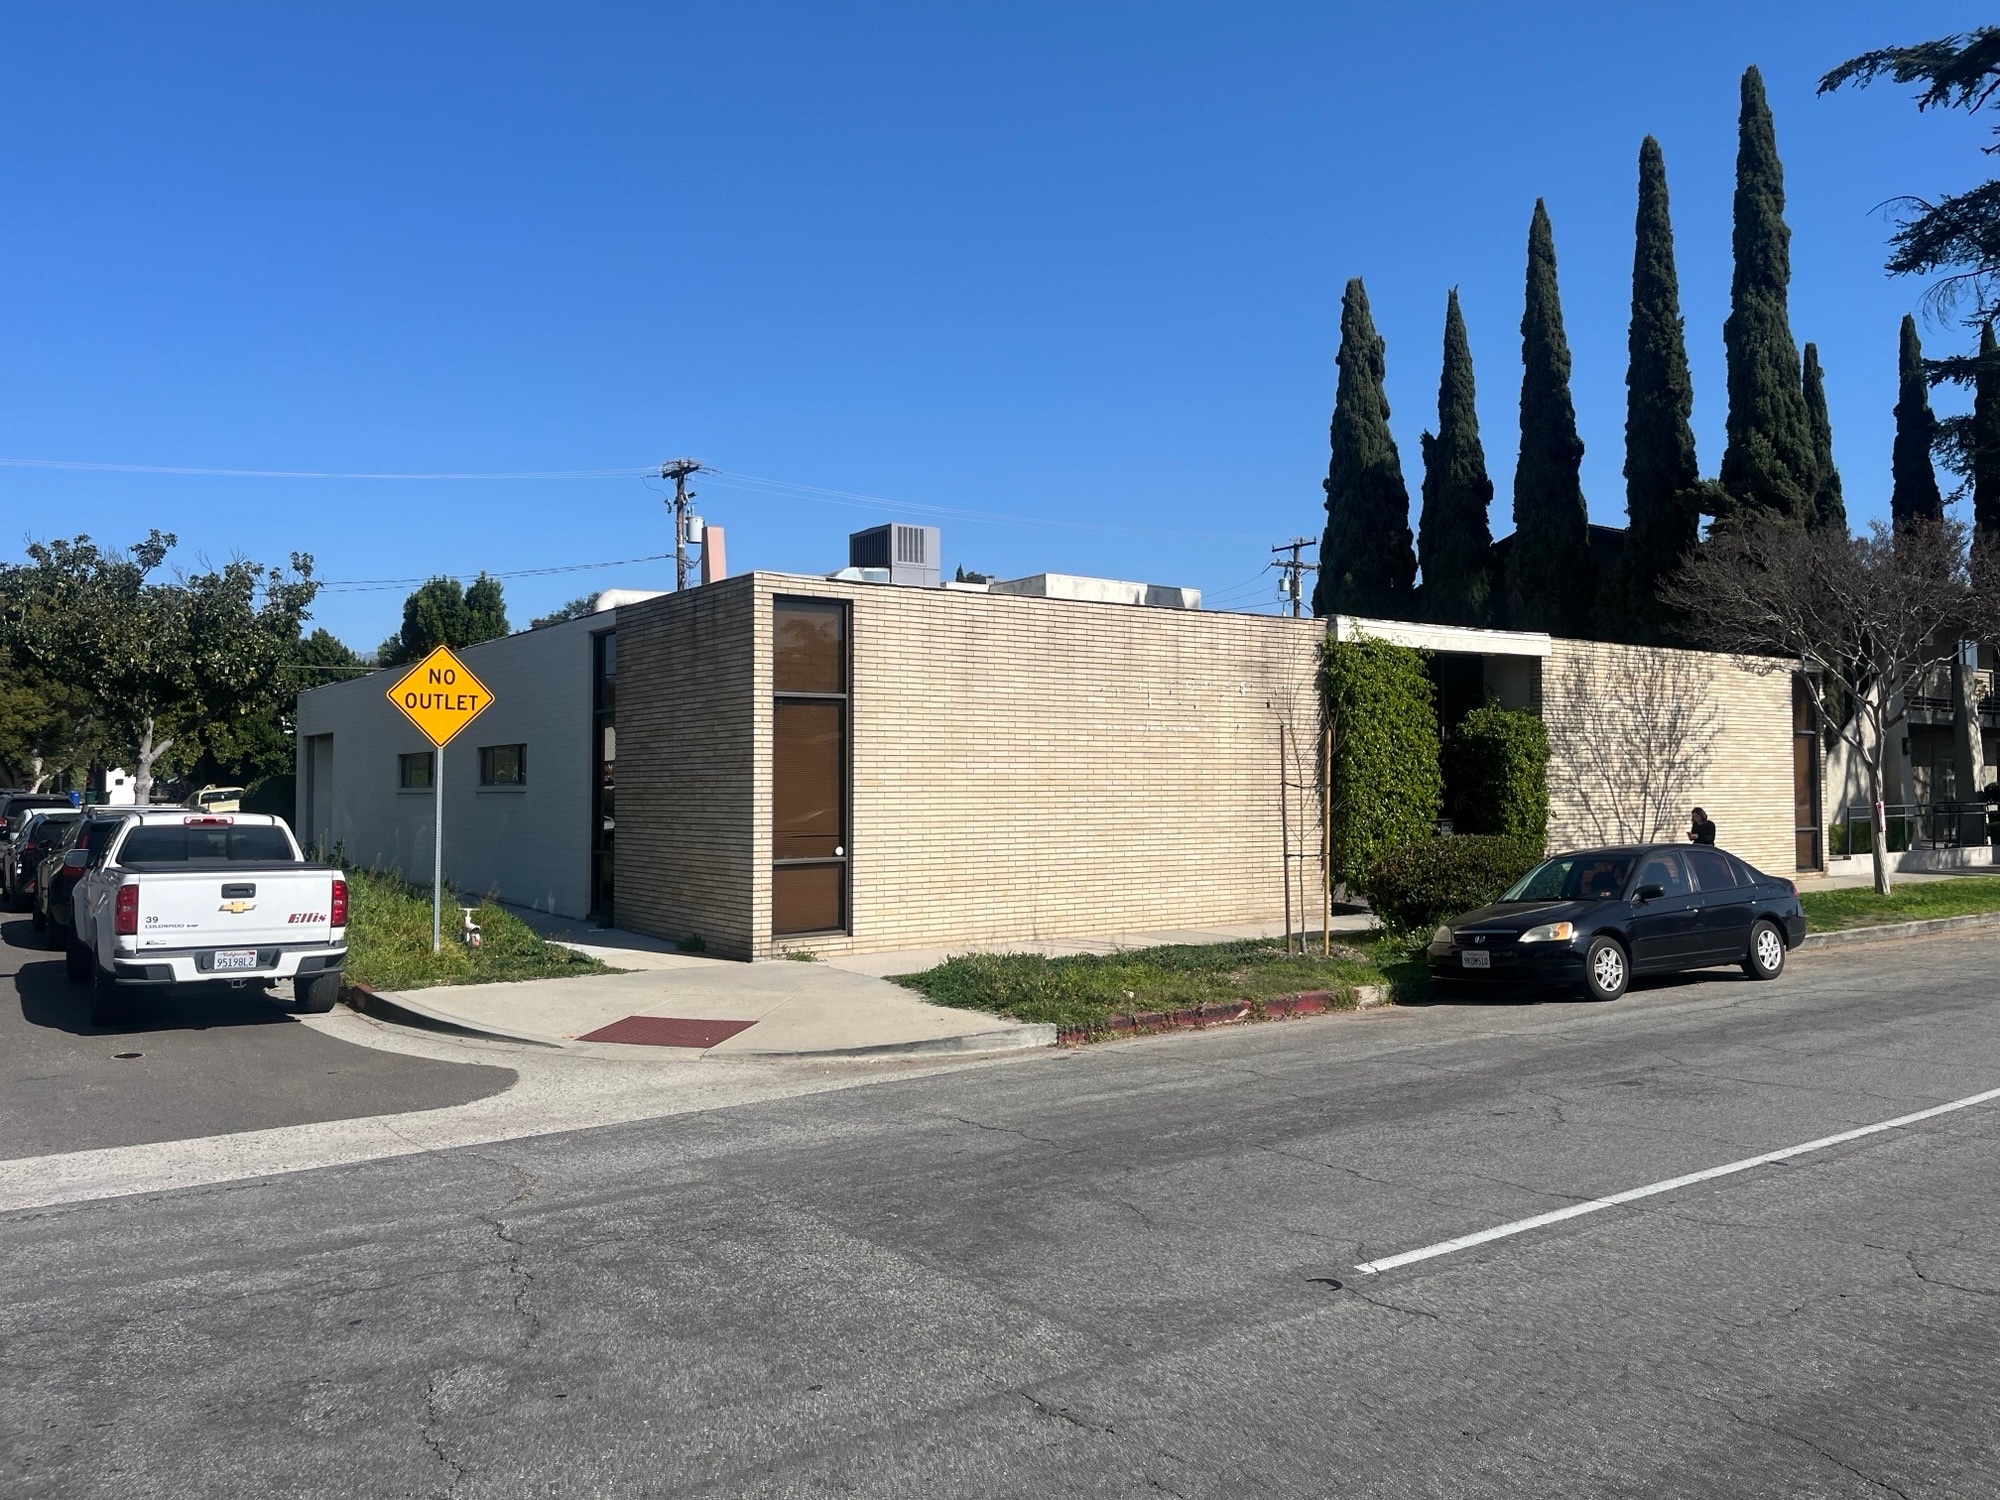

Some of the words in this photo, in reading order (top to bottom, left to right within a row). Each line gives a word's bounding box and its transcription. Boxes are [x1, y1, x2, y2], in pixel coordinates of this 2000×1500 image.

[429, 668, 455, 685] NO
[405, 692, 478, 711] OUTLET
[145, 916, 158, 924] 39
[288, 913, 327, 923] Ellis
